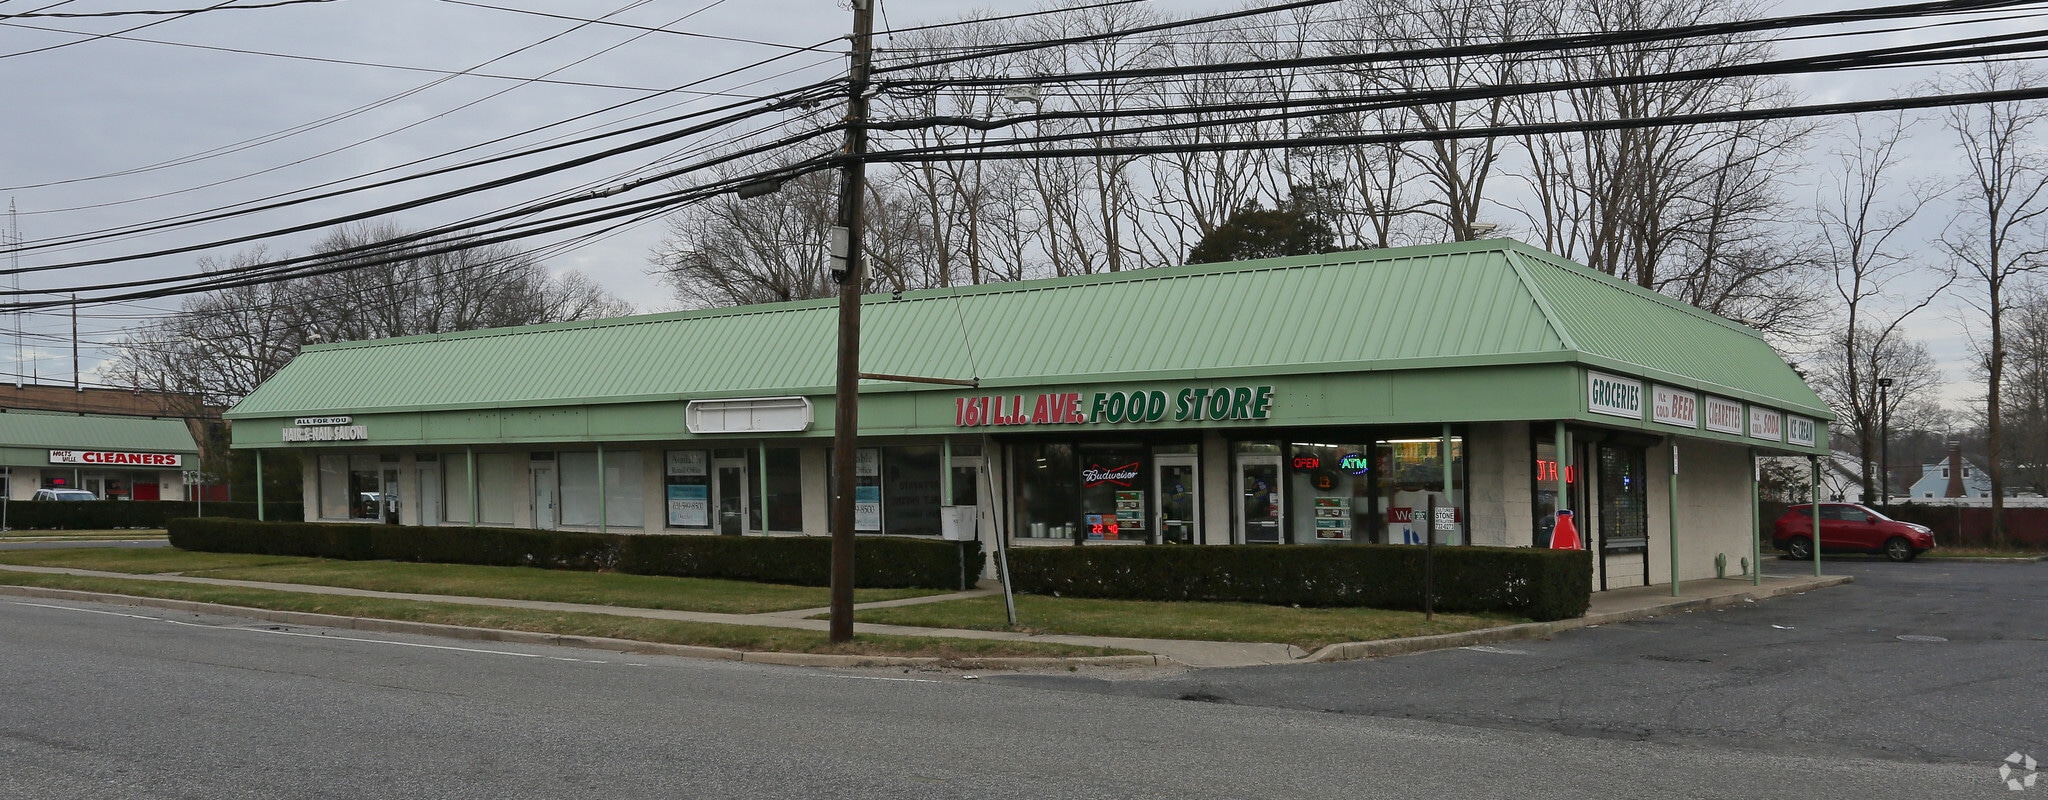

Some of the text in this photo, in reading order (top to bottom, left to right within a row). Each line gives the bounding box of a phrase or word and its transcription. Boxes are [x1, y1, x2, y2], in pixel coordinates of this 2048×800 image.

[1592, 378, 1639, 411] GROCERIES
[955, 385, 1274, 426] 161 L.I. AVE. FOOD STORE
[1656, 405, 1670, 418] COLD
[1671, 394, 1695, 422] BEER
[1709, 402, 1740, 429] CIGARETTES
[1763, 413, 1779, 435] SODA
[1799, 420, 1813, 442] CREAM
[283, 427, 304, 442] HAIR
[312, 426, 334, 441] NAIL
[334, 425, 368, 440] SALON
[82, 452, 176, 465] CLEANERS
[1294, 458, 1319, 468] OPEN
[1341, 458, 1367, 469] ATM
[1083, 469, 1138, 482] Budweiser
[1092, 524, 1103, 534] 22
[1107, 524, 1118, 534] 40
